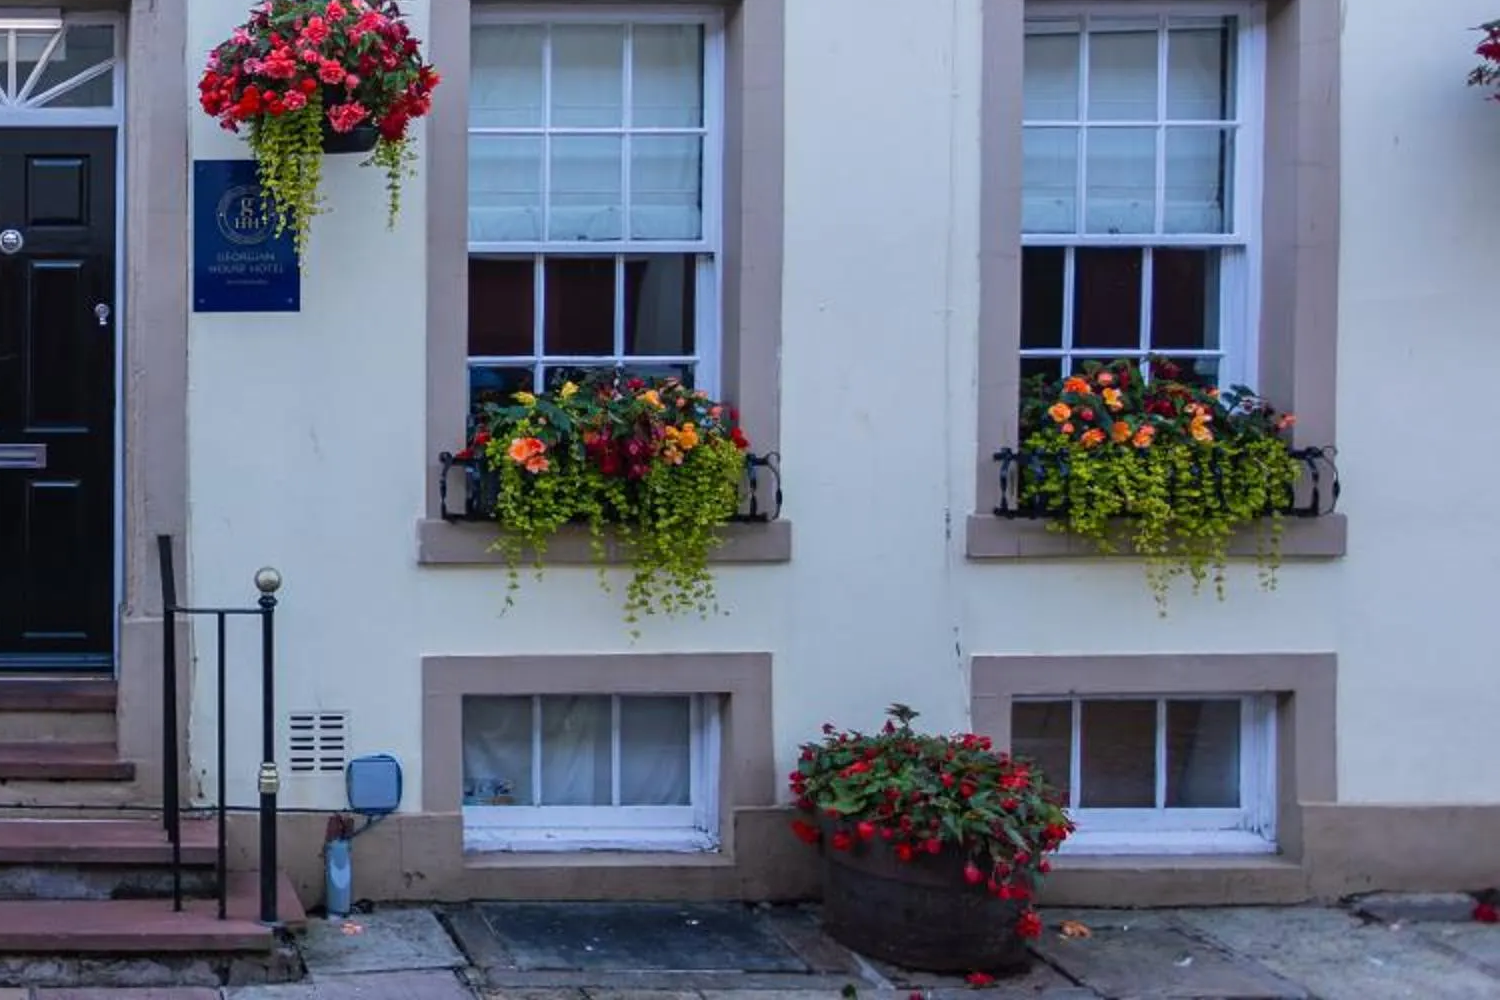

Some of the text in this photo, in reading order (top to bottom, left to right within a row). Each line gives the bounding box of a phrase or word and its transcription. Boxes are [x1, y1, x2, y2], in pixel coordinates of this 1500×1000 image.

[216, 252, 276, 262] GEORGIAN
[208, 264, 284, 274] HOUSE HOTEL
